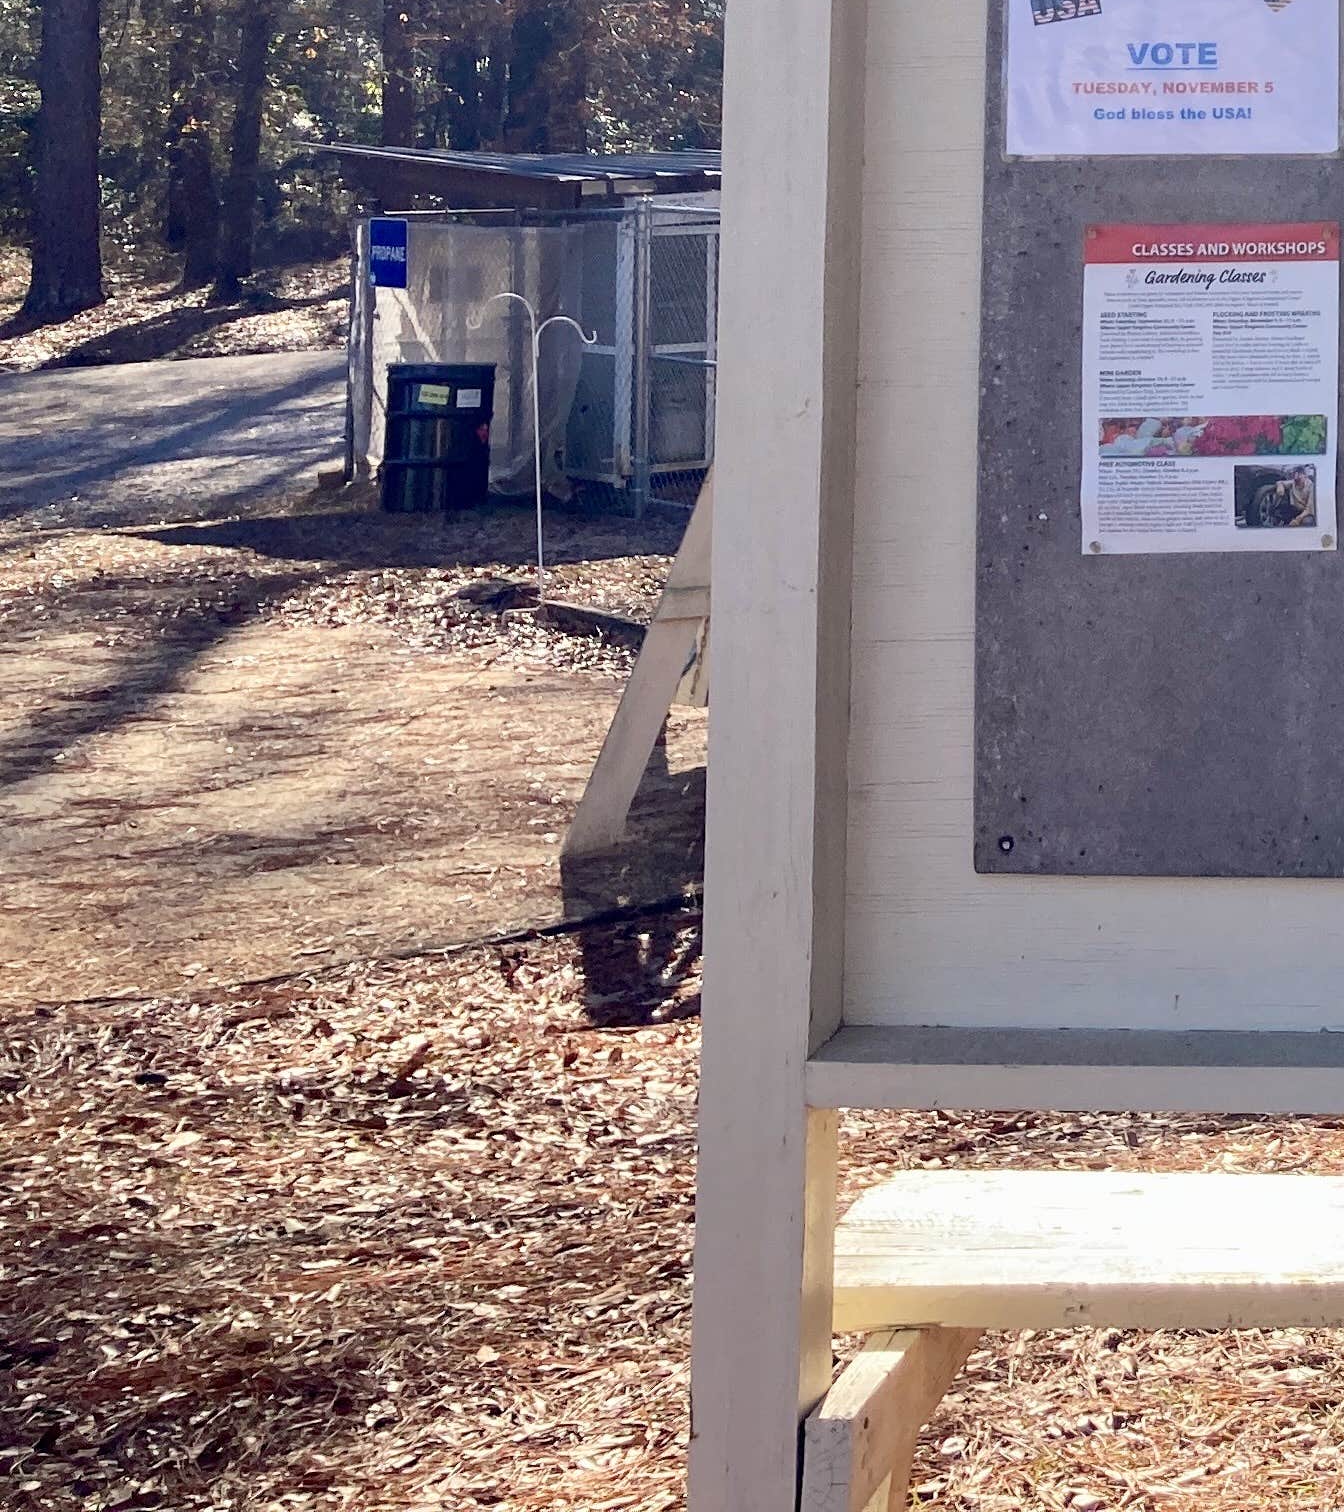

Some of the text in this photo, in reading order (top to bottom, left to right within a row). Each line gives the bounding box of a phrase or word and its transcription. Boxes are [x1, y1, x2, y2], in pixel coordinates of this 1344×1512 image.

[1128, 43, 1218, 65] VOTE
[1073, 82, 1274, 96] TUESDAY, NOVEMBER 5
[1094, 107, 1252, 120] God bless the USA!
[372, 245, 406, 262] PROPANE
[1132, 241, 1326, 256] CLASSES AND WORKSHOPS
[1145, 269, 1267, 289] Gardening Classes
